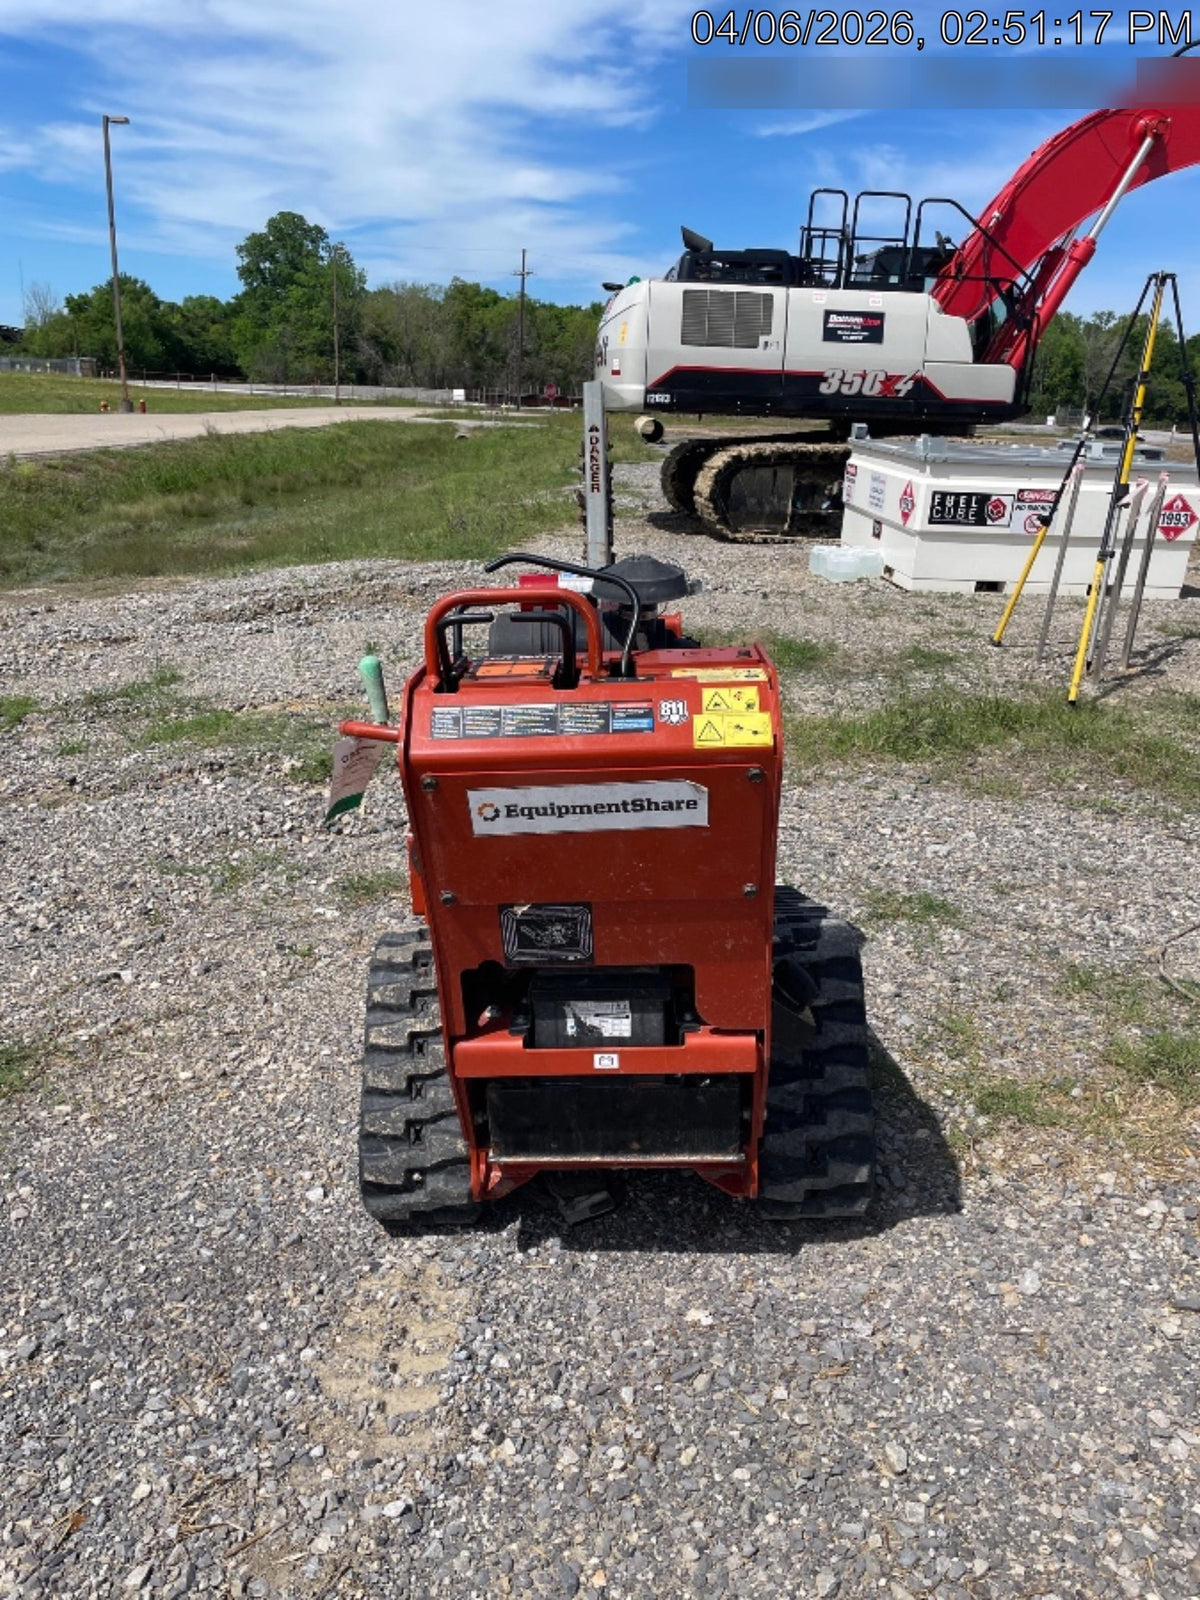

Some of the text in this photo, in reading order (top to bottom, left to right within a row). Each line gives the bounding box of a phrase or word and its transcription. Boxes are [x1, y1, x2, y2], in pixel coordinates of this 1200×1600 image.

[589, 435, 601, 493] DANGER
[934, 494, 979, 507] FUEL
[933, 506, 977, 520] CUBE
[1161, 513, 1188, 526] 1993
[660, 701, 685, 716] 811
[505, 798, 698, 820] EquipmentShare
